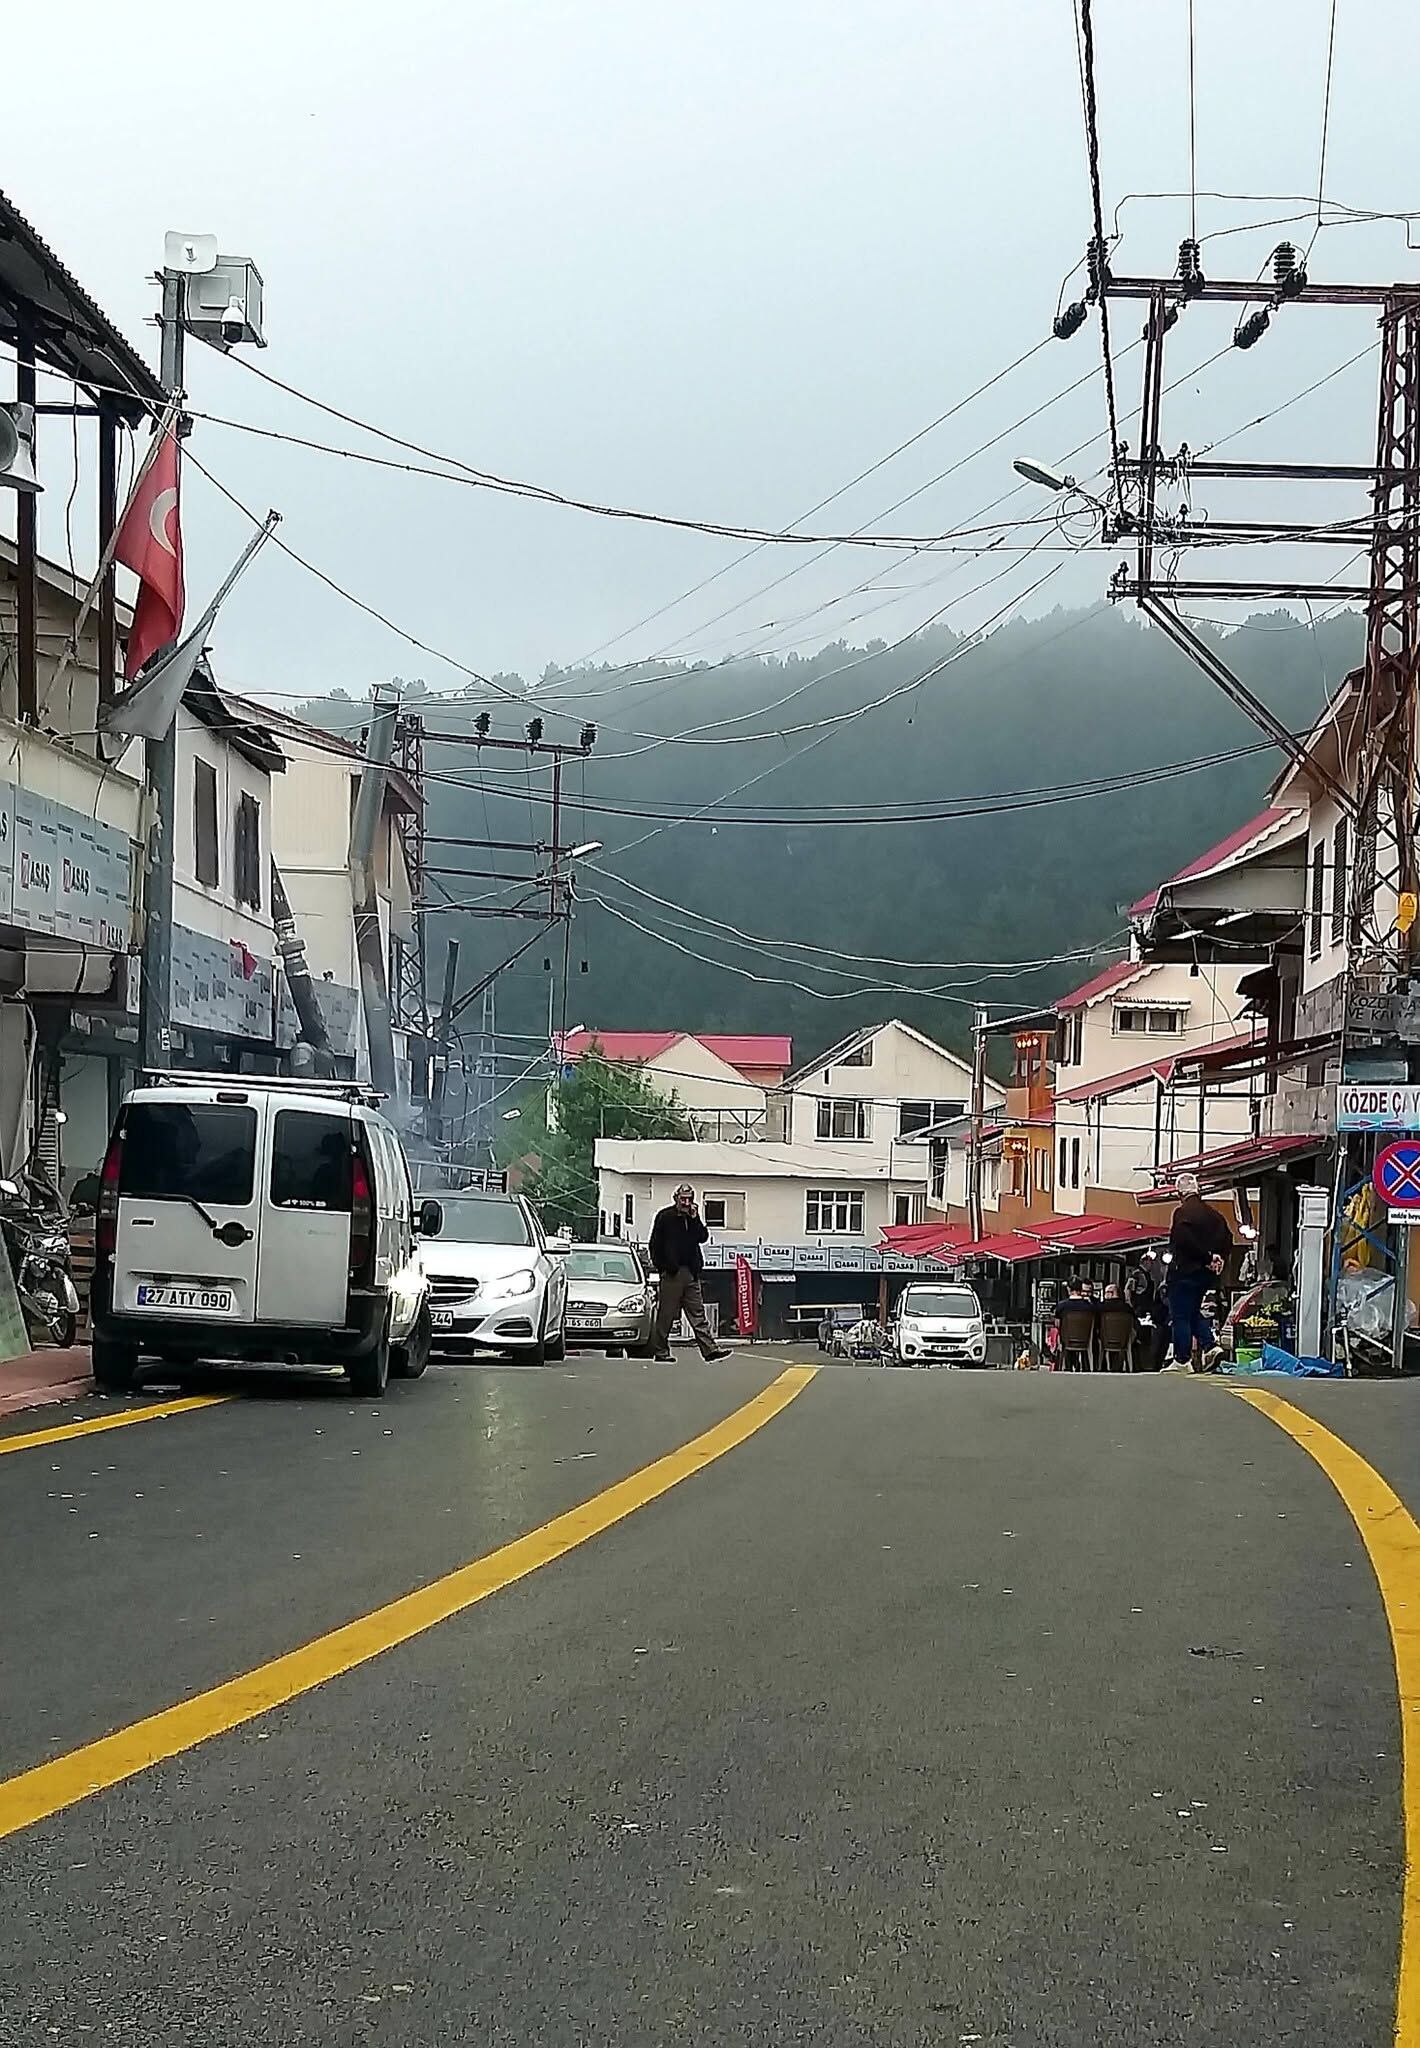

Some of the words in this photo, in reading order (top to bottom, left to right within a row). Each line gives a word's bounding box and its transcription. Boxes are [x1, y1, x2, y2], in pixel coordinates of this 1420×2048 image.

[146, 1289, 165, 1304] 27
[169, 1290, 196, 1306] ATY
[200, 1292, 228, 1309] 090
